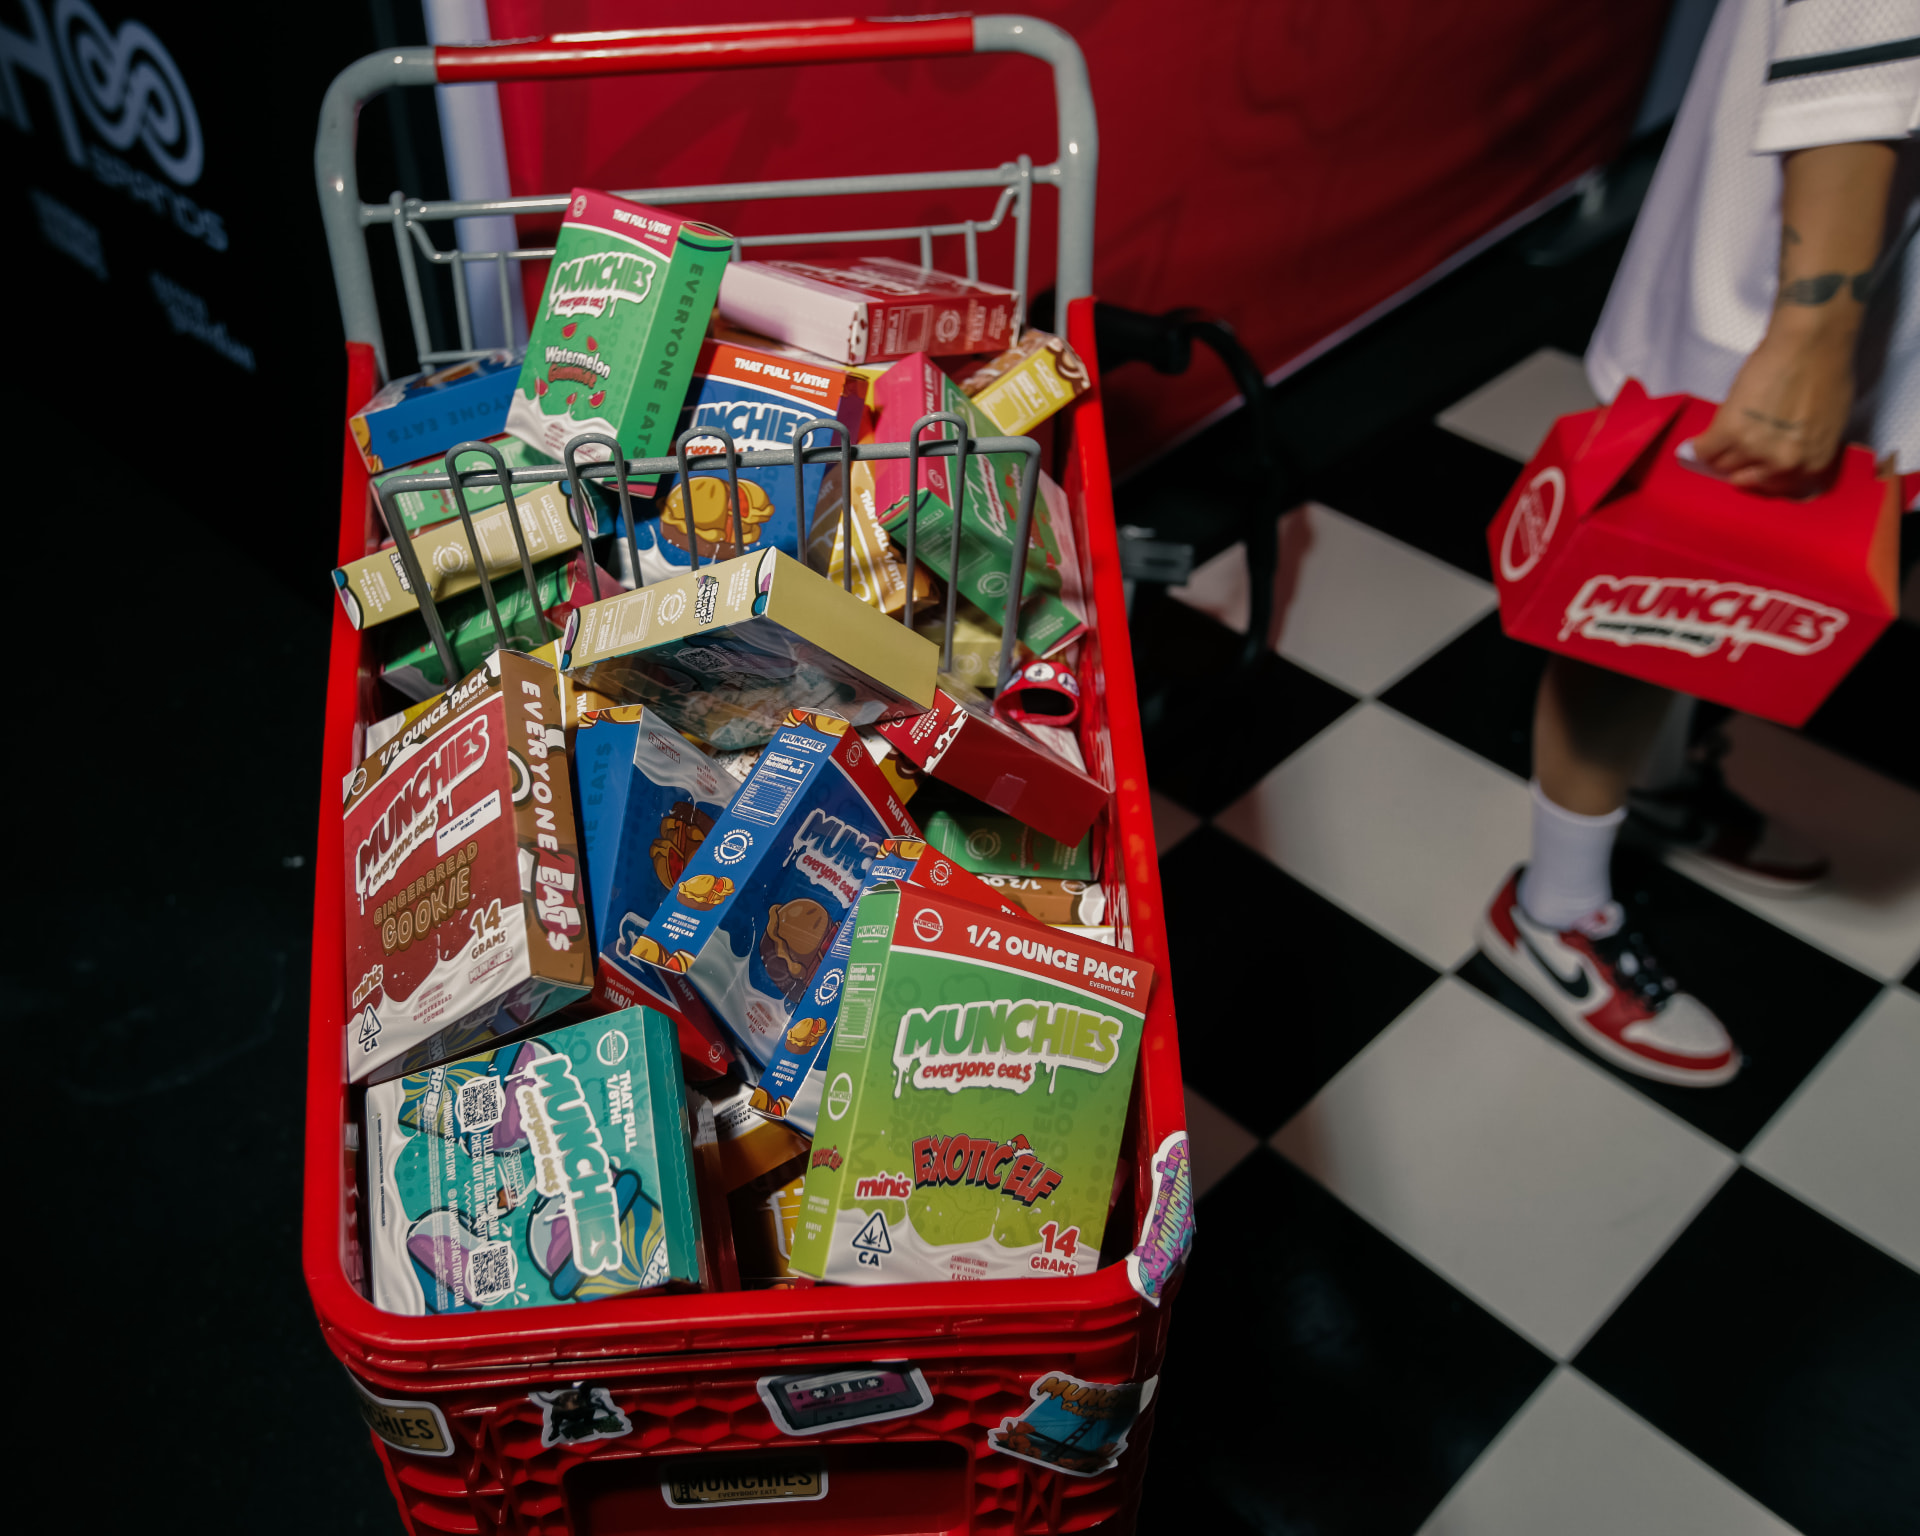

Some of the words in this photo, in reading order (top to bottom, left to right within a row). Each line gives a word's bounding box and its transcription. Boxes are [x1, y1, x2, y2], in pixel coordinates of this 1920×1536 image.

[552, 253, 656, 301] MUNCHIES
[654, 263, 704, 391] EVERYONE
[545, 346, 611, 379] Watermelon
[734, 357, 763, 373] THAT
[763, 364, 790, 381] FULL
[793, 371, 831, 390] 1/8TH!
[633, 402, 660, 459] EATS
[860, 489, 878, 521] THAT
[1580, 576, 1844, 648] MUNCHIES
[379, 740, 400, 767] 1/2
[402, 700, 449, 746] OUNCE
[450, 667, 489, 710] PACK
[769, 753, 794, 766] Cannabis
[779, 732, 828, 753] MUNCHIES
[520, 680, 559, 851] EVERYONE
[765, 759, 789, 771] Nutrition
[356, 714, 491, 886] MUNCHIES
[885, 795, 904, 822] THAT
[372, 829, 414, 886] everyone
[802, 853, 842, 889] everyone
[871, 865, 907, 879] MUNCHIES
[374, 840, 479, 926] GINGERBREAD
[382, 867, 471, 956] COOKIE
[470, 898, 502, 940] 14
[537, 866, 574, 952] EATS
[912, 918, 944, 931] MUNCHIES
[471, 928, 508, 960] GRAMS
[662, 922, 695, 938] AMERICAN
[668, 932, 680, 940] PIE
[857, 925, 889, 938] MUNCHIES
[468, 949, 513, 984] MUNCHIES
[966, 924, 1001, 951] 1/2
[1005, 936, 1080, 973] OUNCE
[1083, 957, 1138, 989] PACK
[353, 964, 384, 1008] minis
[1089, 980, 1120, 994] EVERYONE
[364, 1036, 379, 1053] CA
[901, 1002, 1121, 1066] MUNCHIES
[772, 1071, 795, 1083] AMERICAN
[922, 1061, 995, 1083] everyone
[606, 1073, 623, 1126] 1/8TH!
[619, 1069, 634, 1112] THAT
[470, 1133, 484, 1164] CHECK
[622, 1112, 638, 1153] FULL
[482, 1132, 495, 1169] FOLLOW
[532, 1058, 620, 1272] MUNCHIES
[472, 1163, 485, 1182] OUT
[484, 1168, 497, 1188] THE
[856, 1172, 912, 1199] minis
[912, 1133, 1012, 1190] EXOTIC
[1001, 1154, 1064, 1208] ELF
[473, 1182, 486, 1203] OUR
[1156, 1157, 1192, 1260] MUNCHIES
[1041, 1223, 1078, 1258] 14
[858, 1251, 880, 1267] CA
[1031, 1256, 1077, 1278] GRAMS
[718, 1489, 759, 1499] EVERYBODY
[759, 1488, 777, 1496] EATS
